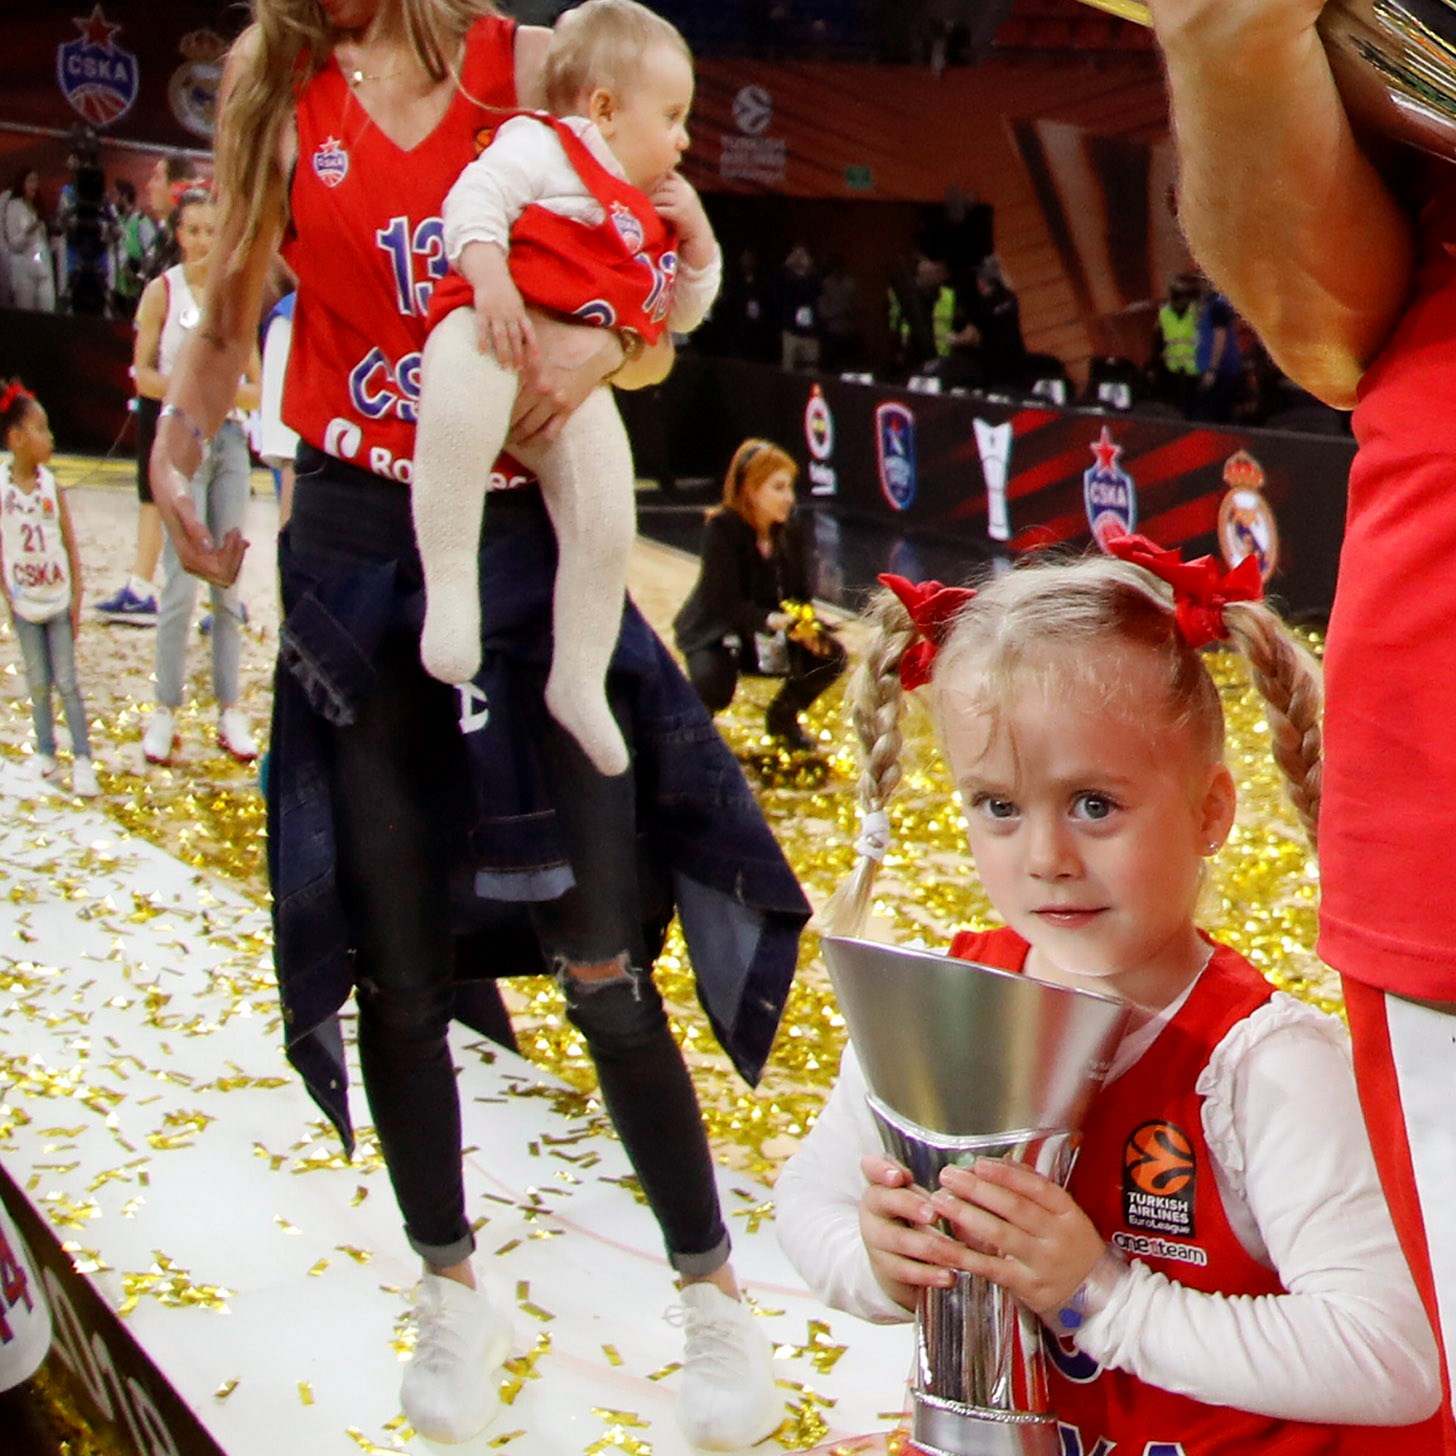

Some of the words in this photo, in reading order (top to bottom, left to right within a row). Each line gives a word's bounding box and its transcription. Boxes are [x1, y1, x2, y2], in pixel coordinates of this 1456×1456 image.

[68, 51, 130, 84] CSKA
[349, 346, 421, 423] CS
[21, 523, 46, 553] 21
[13, 560, 65, 587] CSKA
[1127, 1191, 1189, 1212] TURKISH
[1128, 1204, 1189, 1224] AIRLINES
[1128, 1214, 1190, 1235] EuroLeague
